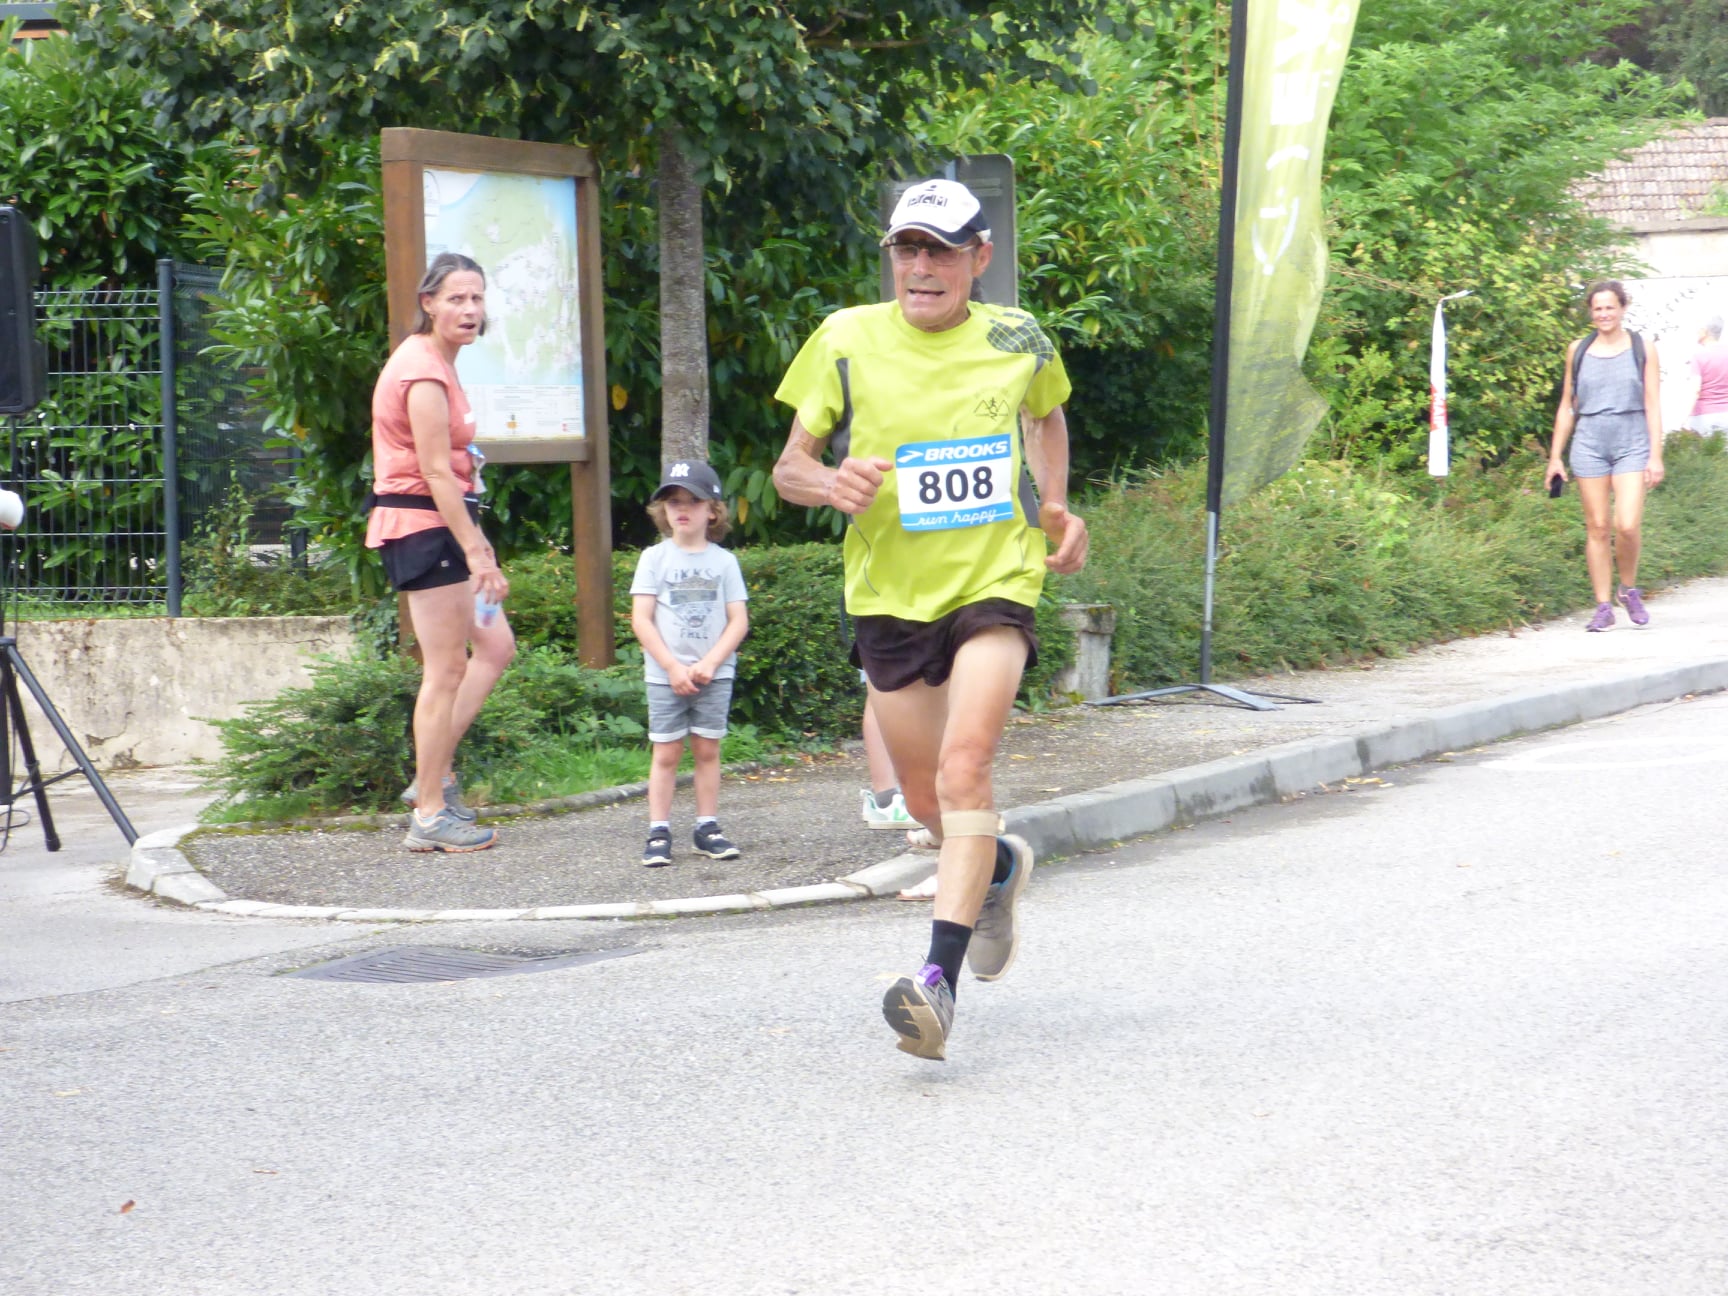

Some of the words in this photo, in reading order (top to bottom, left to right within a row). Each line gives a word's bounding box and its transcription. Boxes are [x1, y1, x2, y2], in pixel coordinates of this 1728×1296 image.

[924, 441, 1009, 461] BROOKS
[918, 466, 994, 505] 808
[917, 515, 948, 526] run
[950, 508, 998, 523] happy
